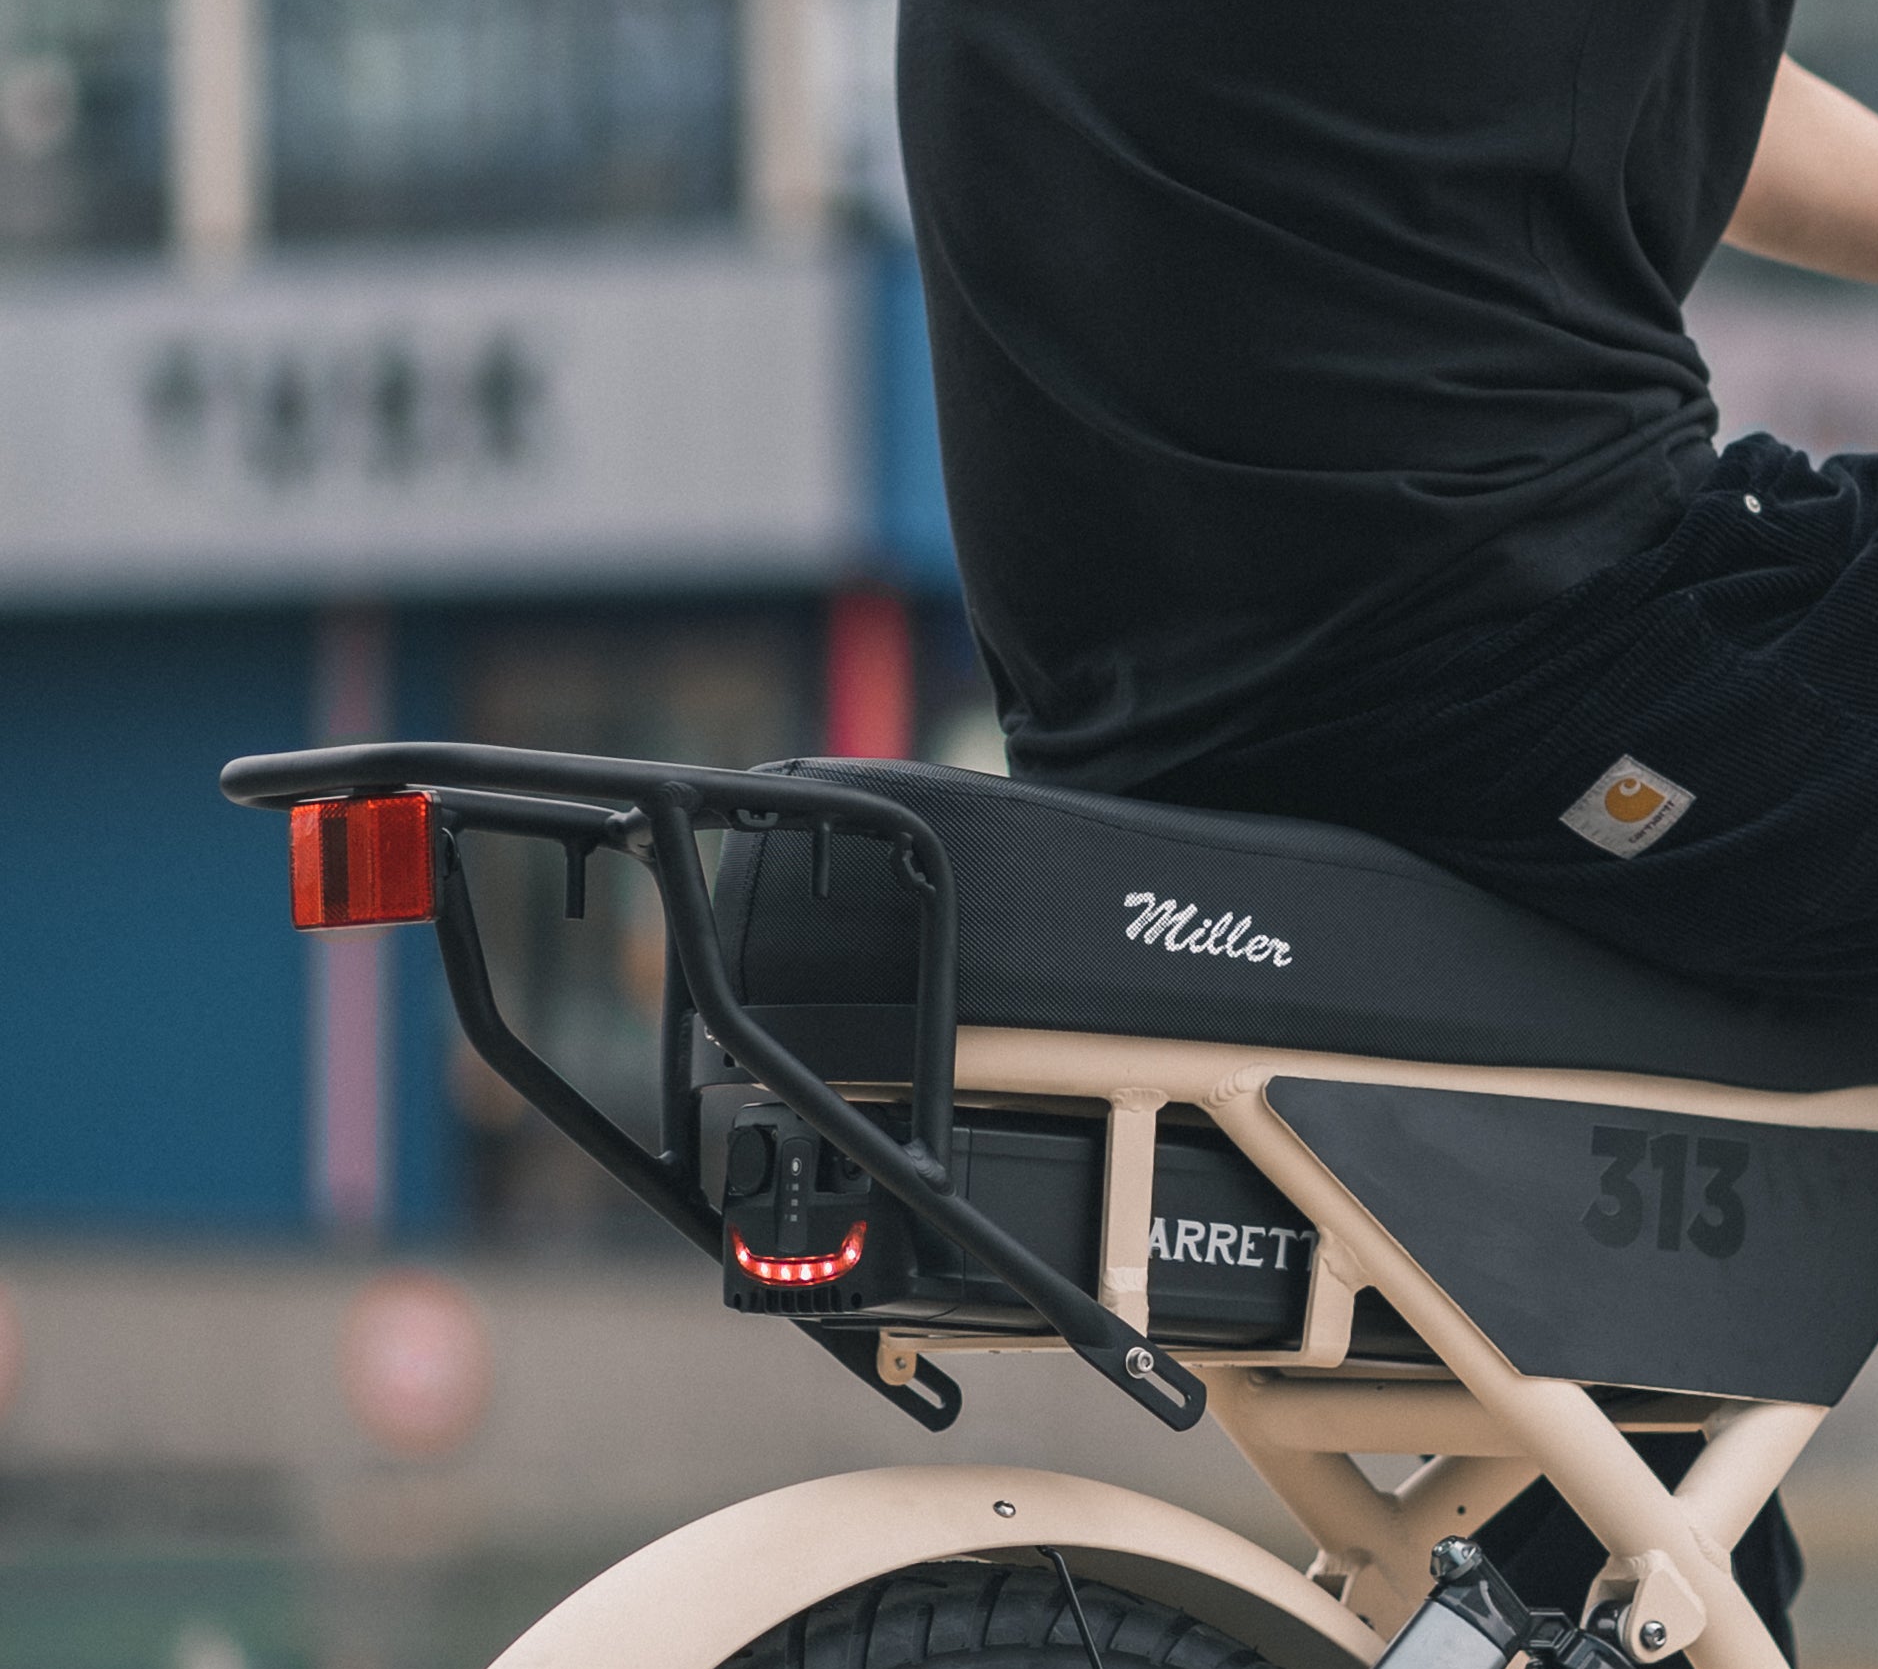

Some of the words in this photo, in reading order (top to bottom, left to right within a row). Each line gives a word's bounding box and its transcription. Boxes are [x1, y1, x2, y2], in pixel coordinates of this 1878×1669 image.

[1629, 799, 1675, 843] carhartt
[1123, 891, 1292, 968] Miller
[1579, 1125, 1750, 1260] 313
